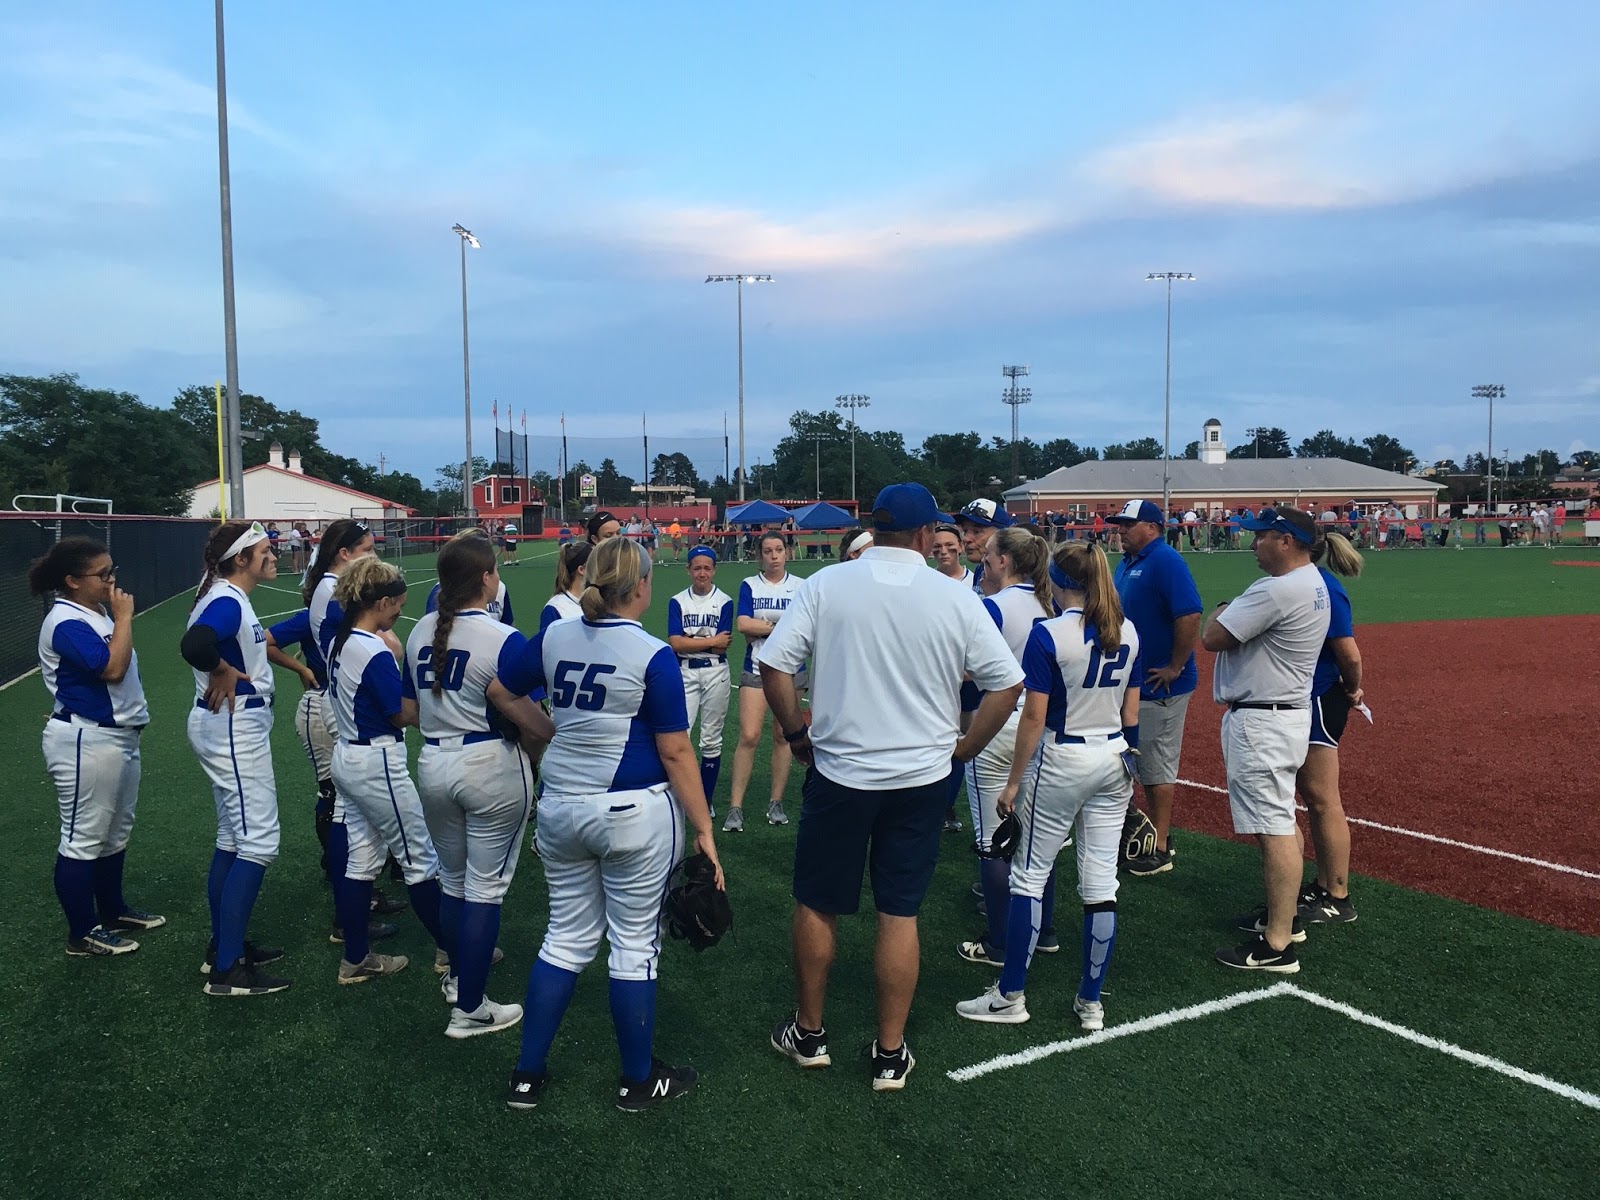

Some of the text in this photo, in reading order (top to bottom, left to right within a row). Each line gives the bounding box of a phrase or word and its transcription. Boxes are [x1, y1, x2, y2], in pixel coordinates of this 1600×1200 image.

[416, 645, 471, 692] 20
[553, 660, 617, 711] 55
[1082, 643, 1131, 689] 12
